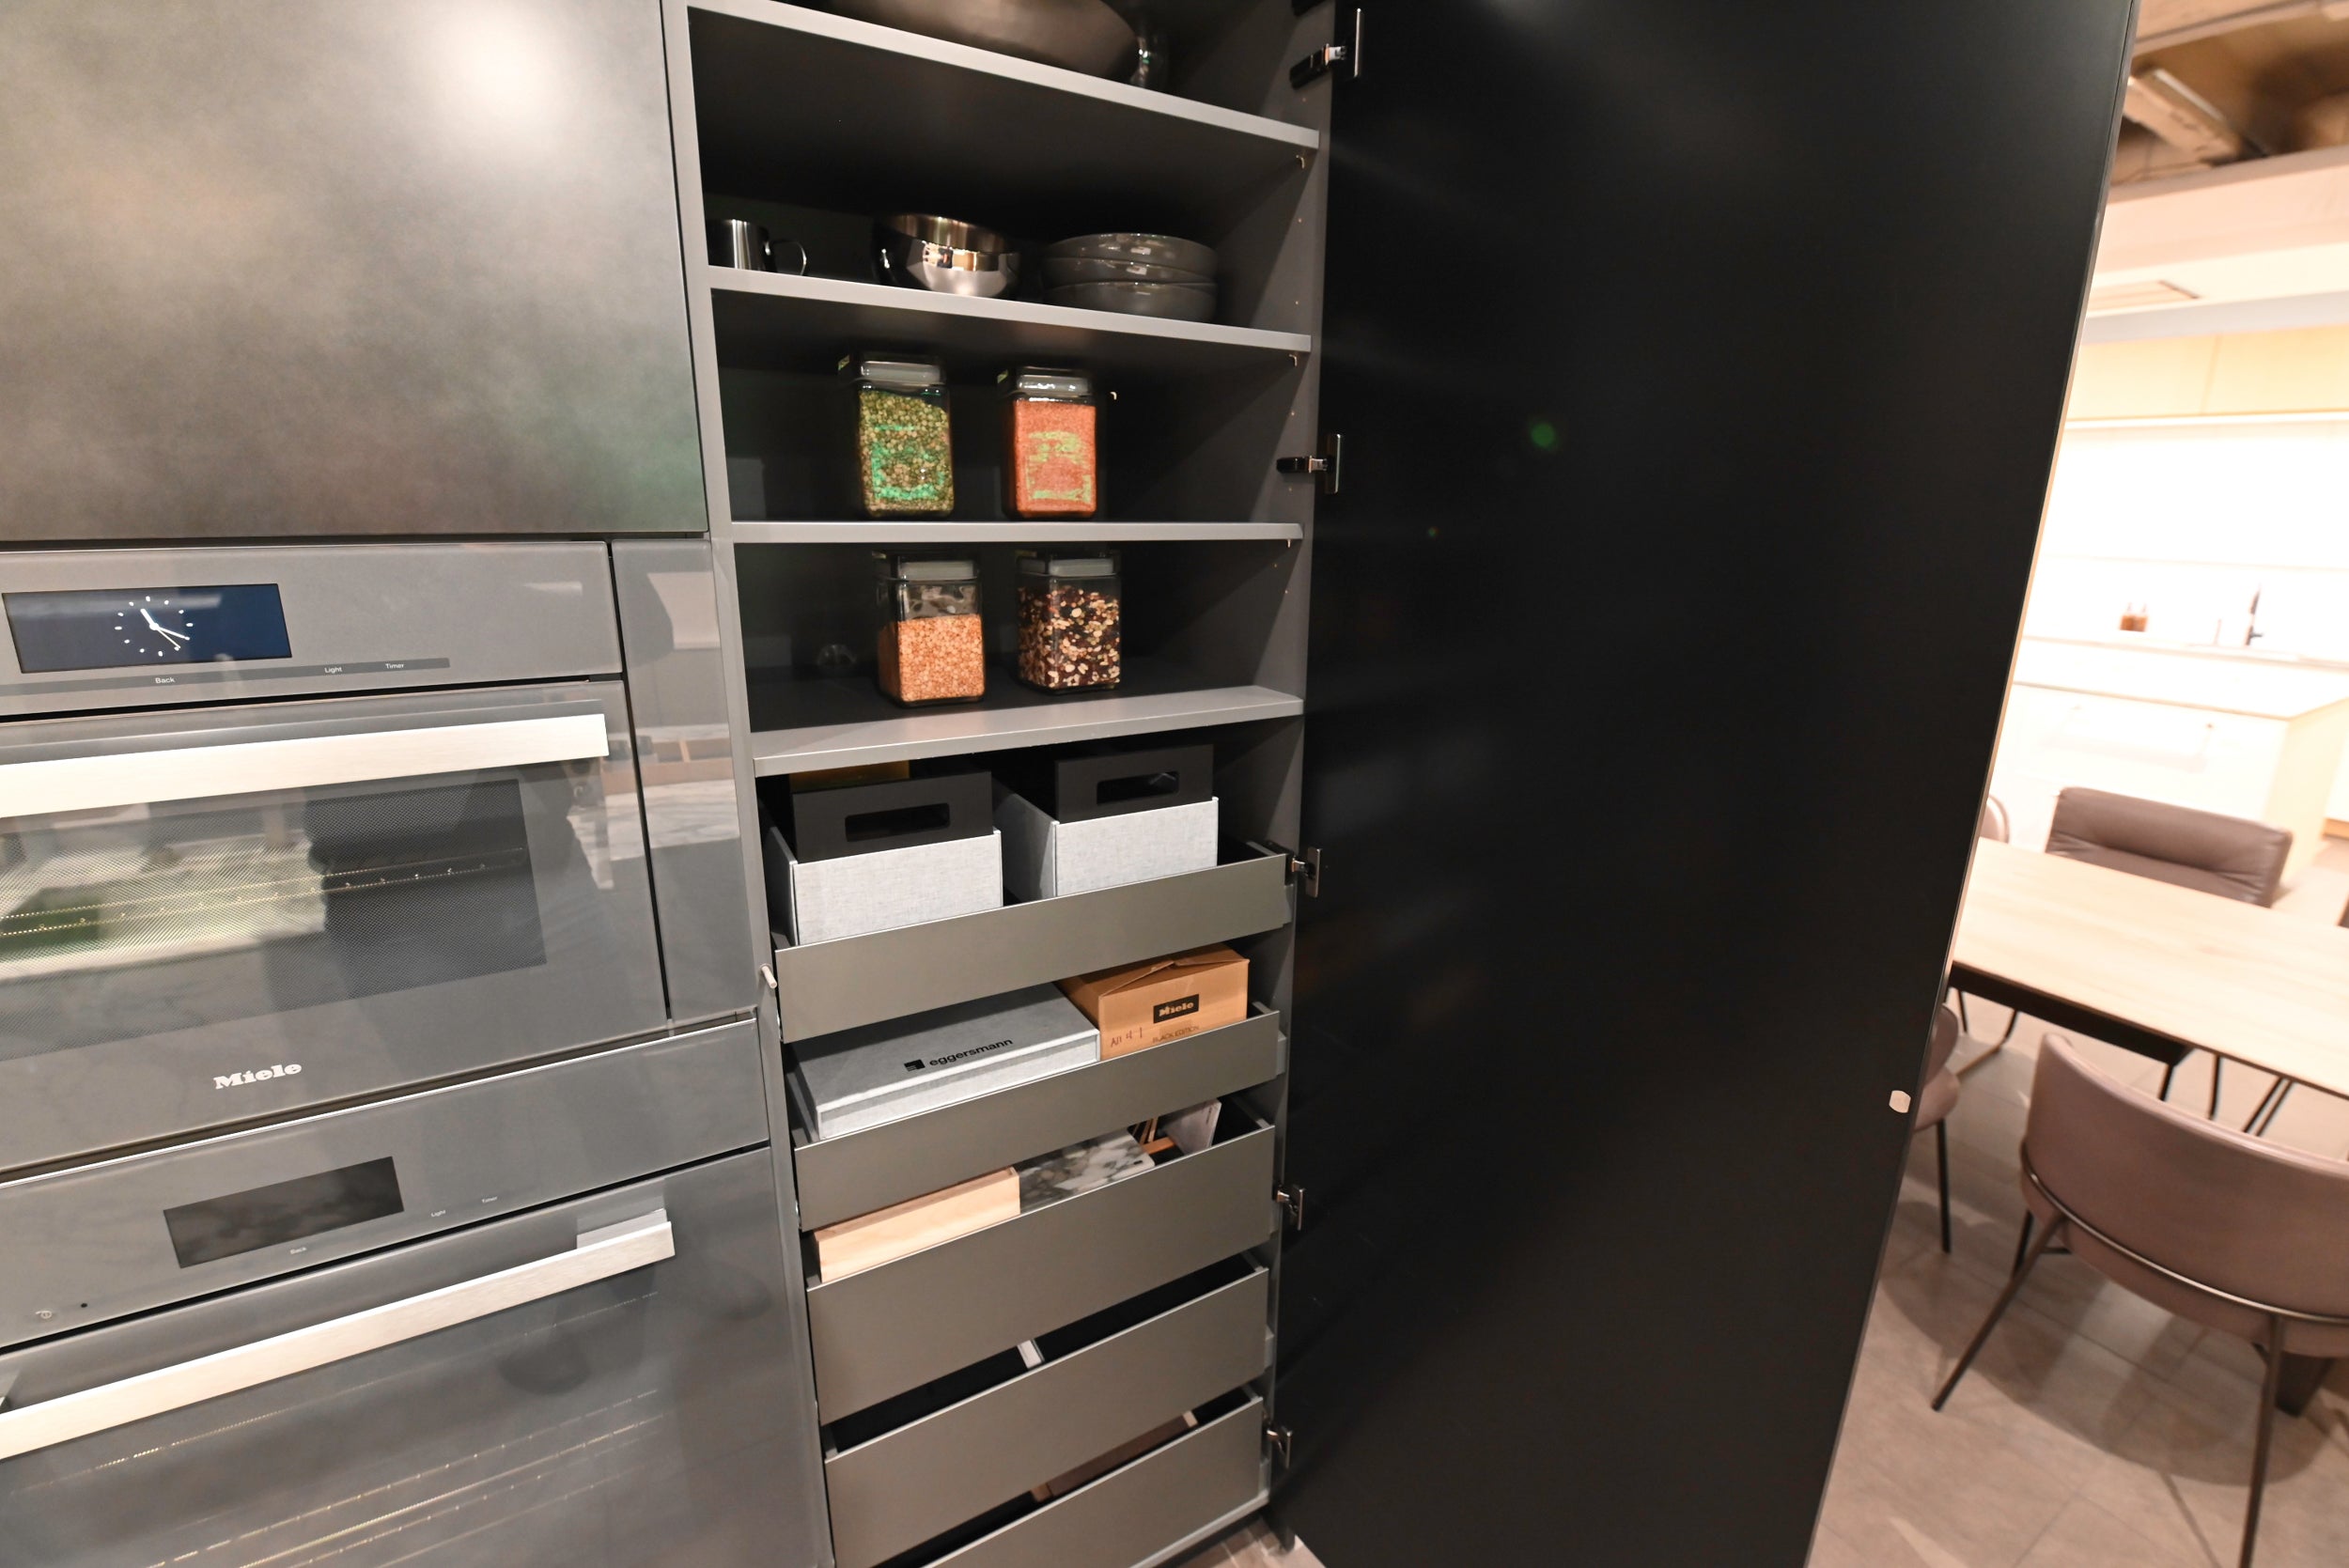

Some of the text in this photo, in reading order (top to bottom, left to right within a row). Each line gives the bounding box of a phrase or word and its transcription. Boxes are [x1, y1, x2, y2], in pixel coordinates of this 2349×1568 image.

[324, 666, 343, 675] Light
[155, 676, 176, 685] Back
[1159, 1001, 1194, 1017] Miele
[929, 1039, 1014, 1065] eggersmann
[213, 1063, 303, 1090] Miele
